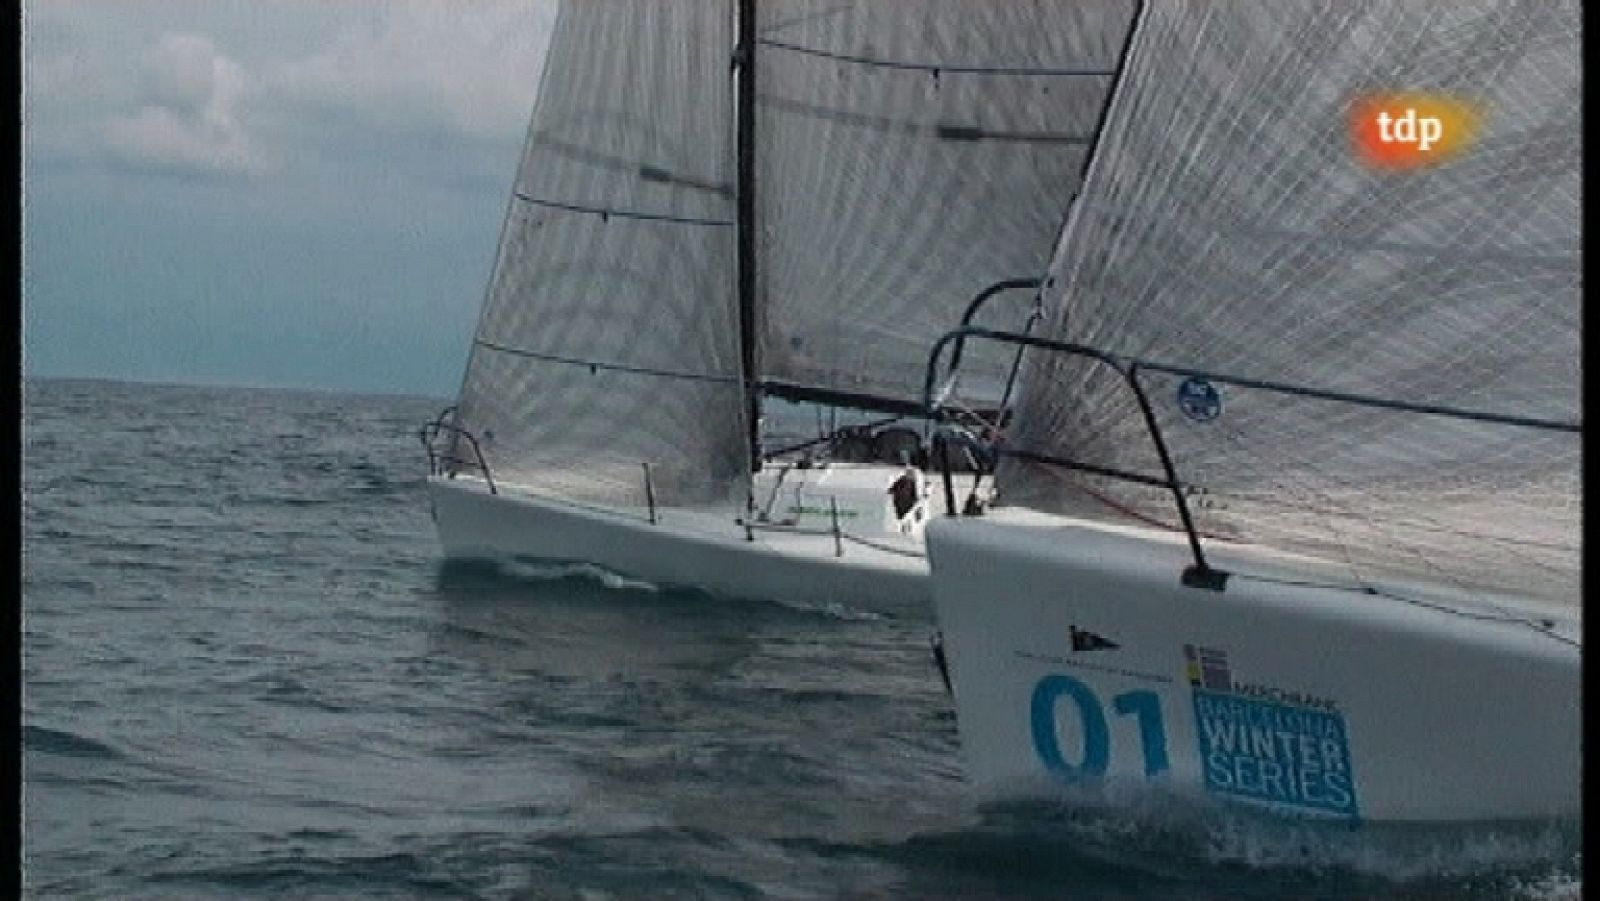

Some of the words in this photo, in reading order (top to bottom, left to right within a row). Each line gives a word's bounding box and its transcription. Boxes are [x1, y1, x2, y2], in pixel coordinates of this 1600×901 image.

[1030, 673, 1170, 782] 01
[1202, 717, 1347, 771] WINTER
[1207, 752, 1352, 808] SERIES
